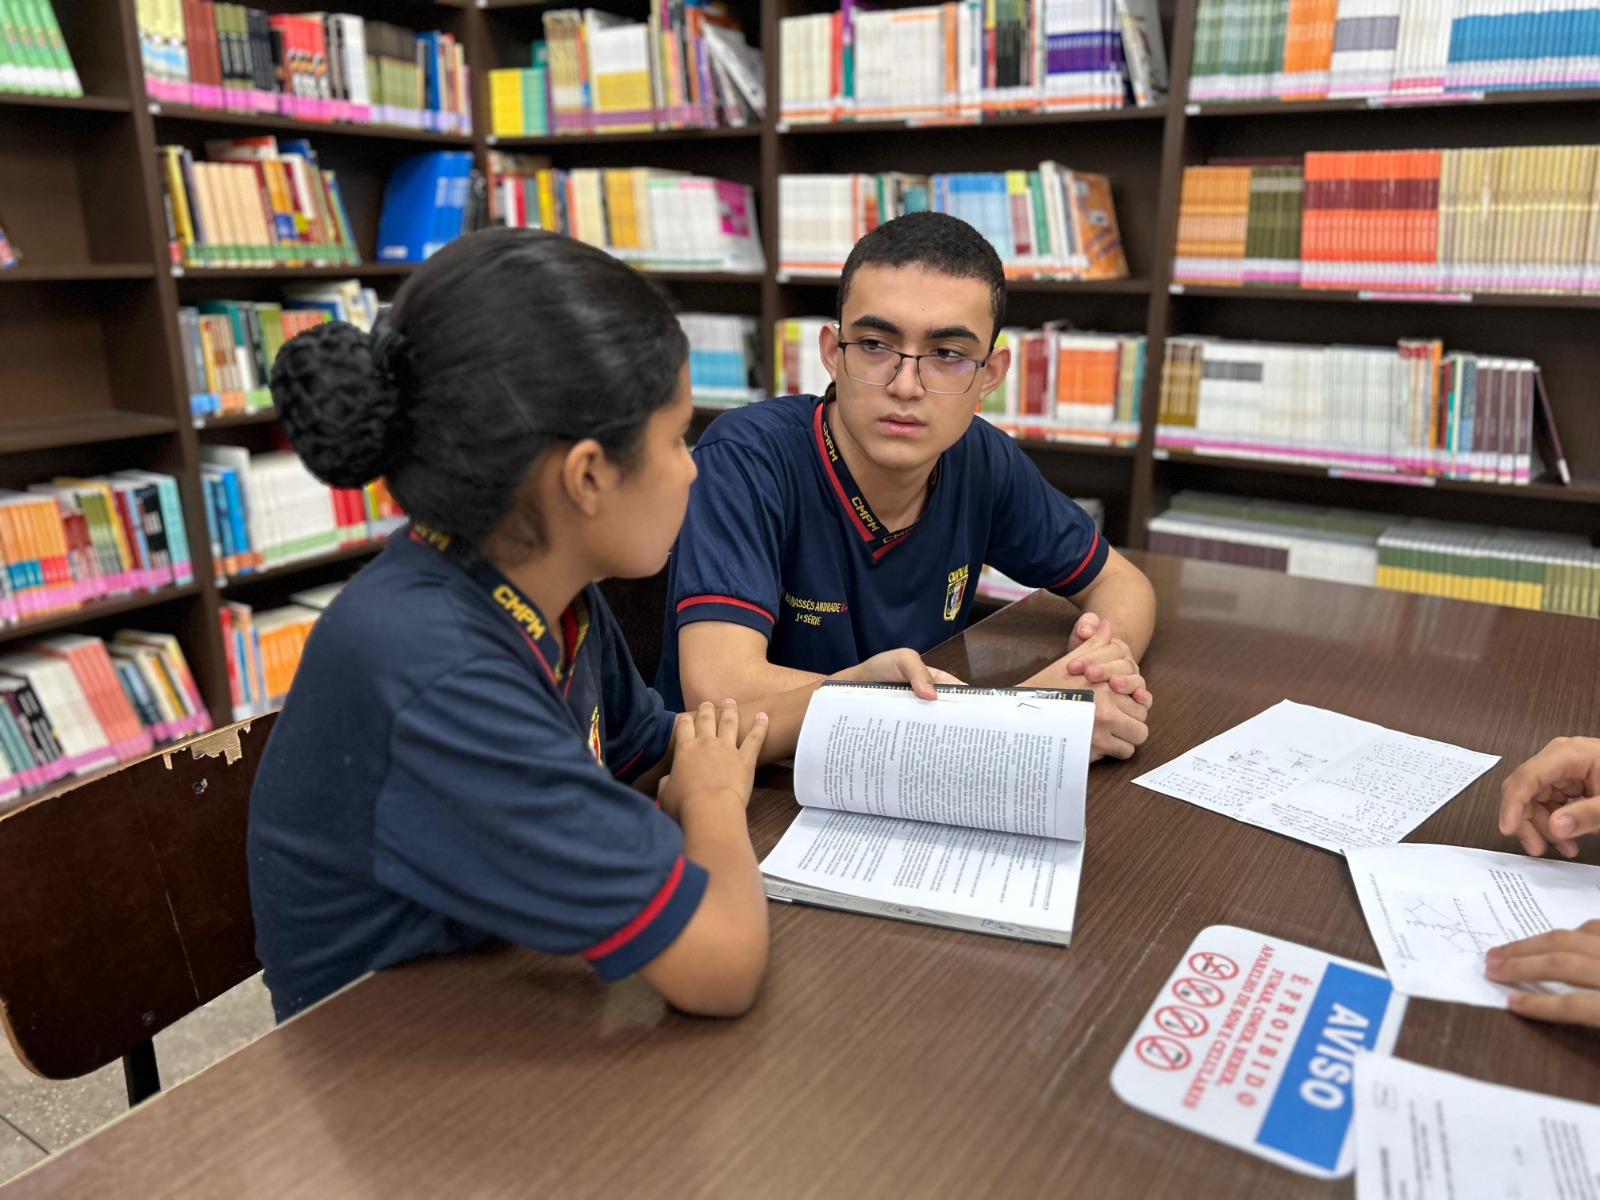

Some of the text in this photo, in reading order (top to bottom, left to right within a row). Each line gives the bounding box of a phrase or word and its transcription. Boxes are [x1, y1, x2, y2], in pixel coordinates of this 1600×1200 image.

[822, 421, 838, 462] CMPM
[851, 496, 880, 530] CMPM
[493, 584, 545, 640] CMPM
[1241, 944, 1276, 994] APARELHO
[1235, 989, 1304, 1108] PROIBIDO
[1299, 1002, 1370, 1110] AVISO
